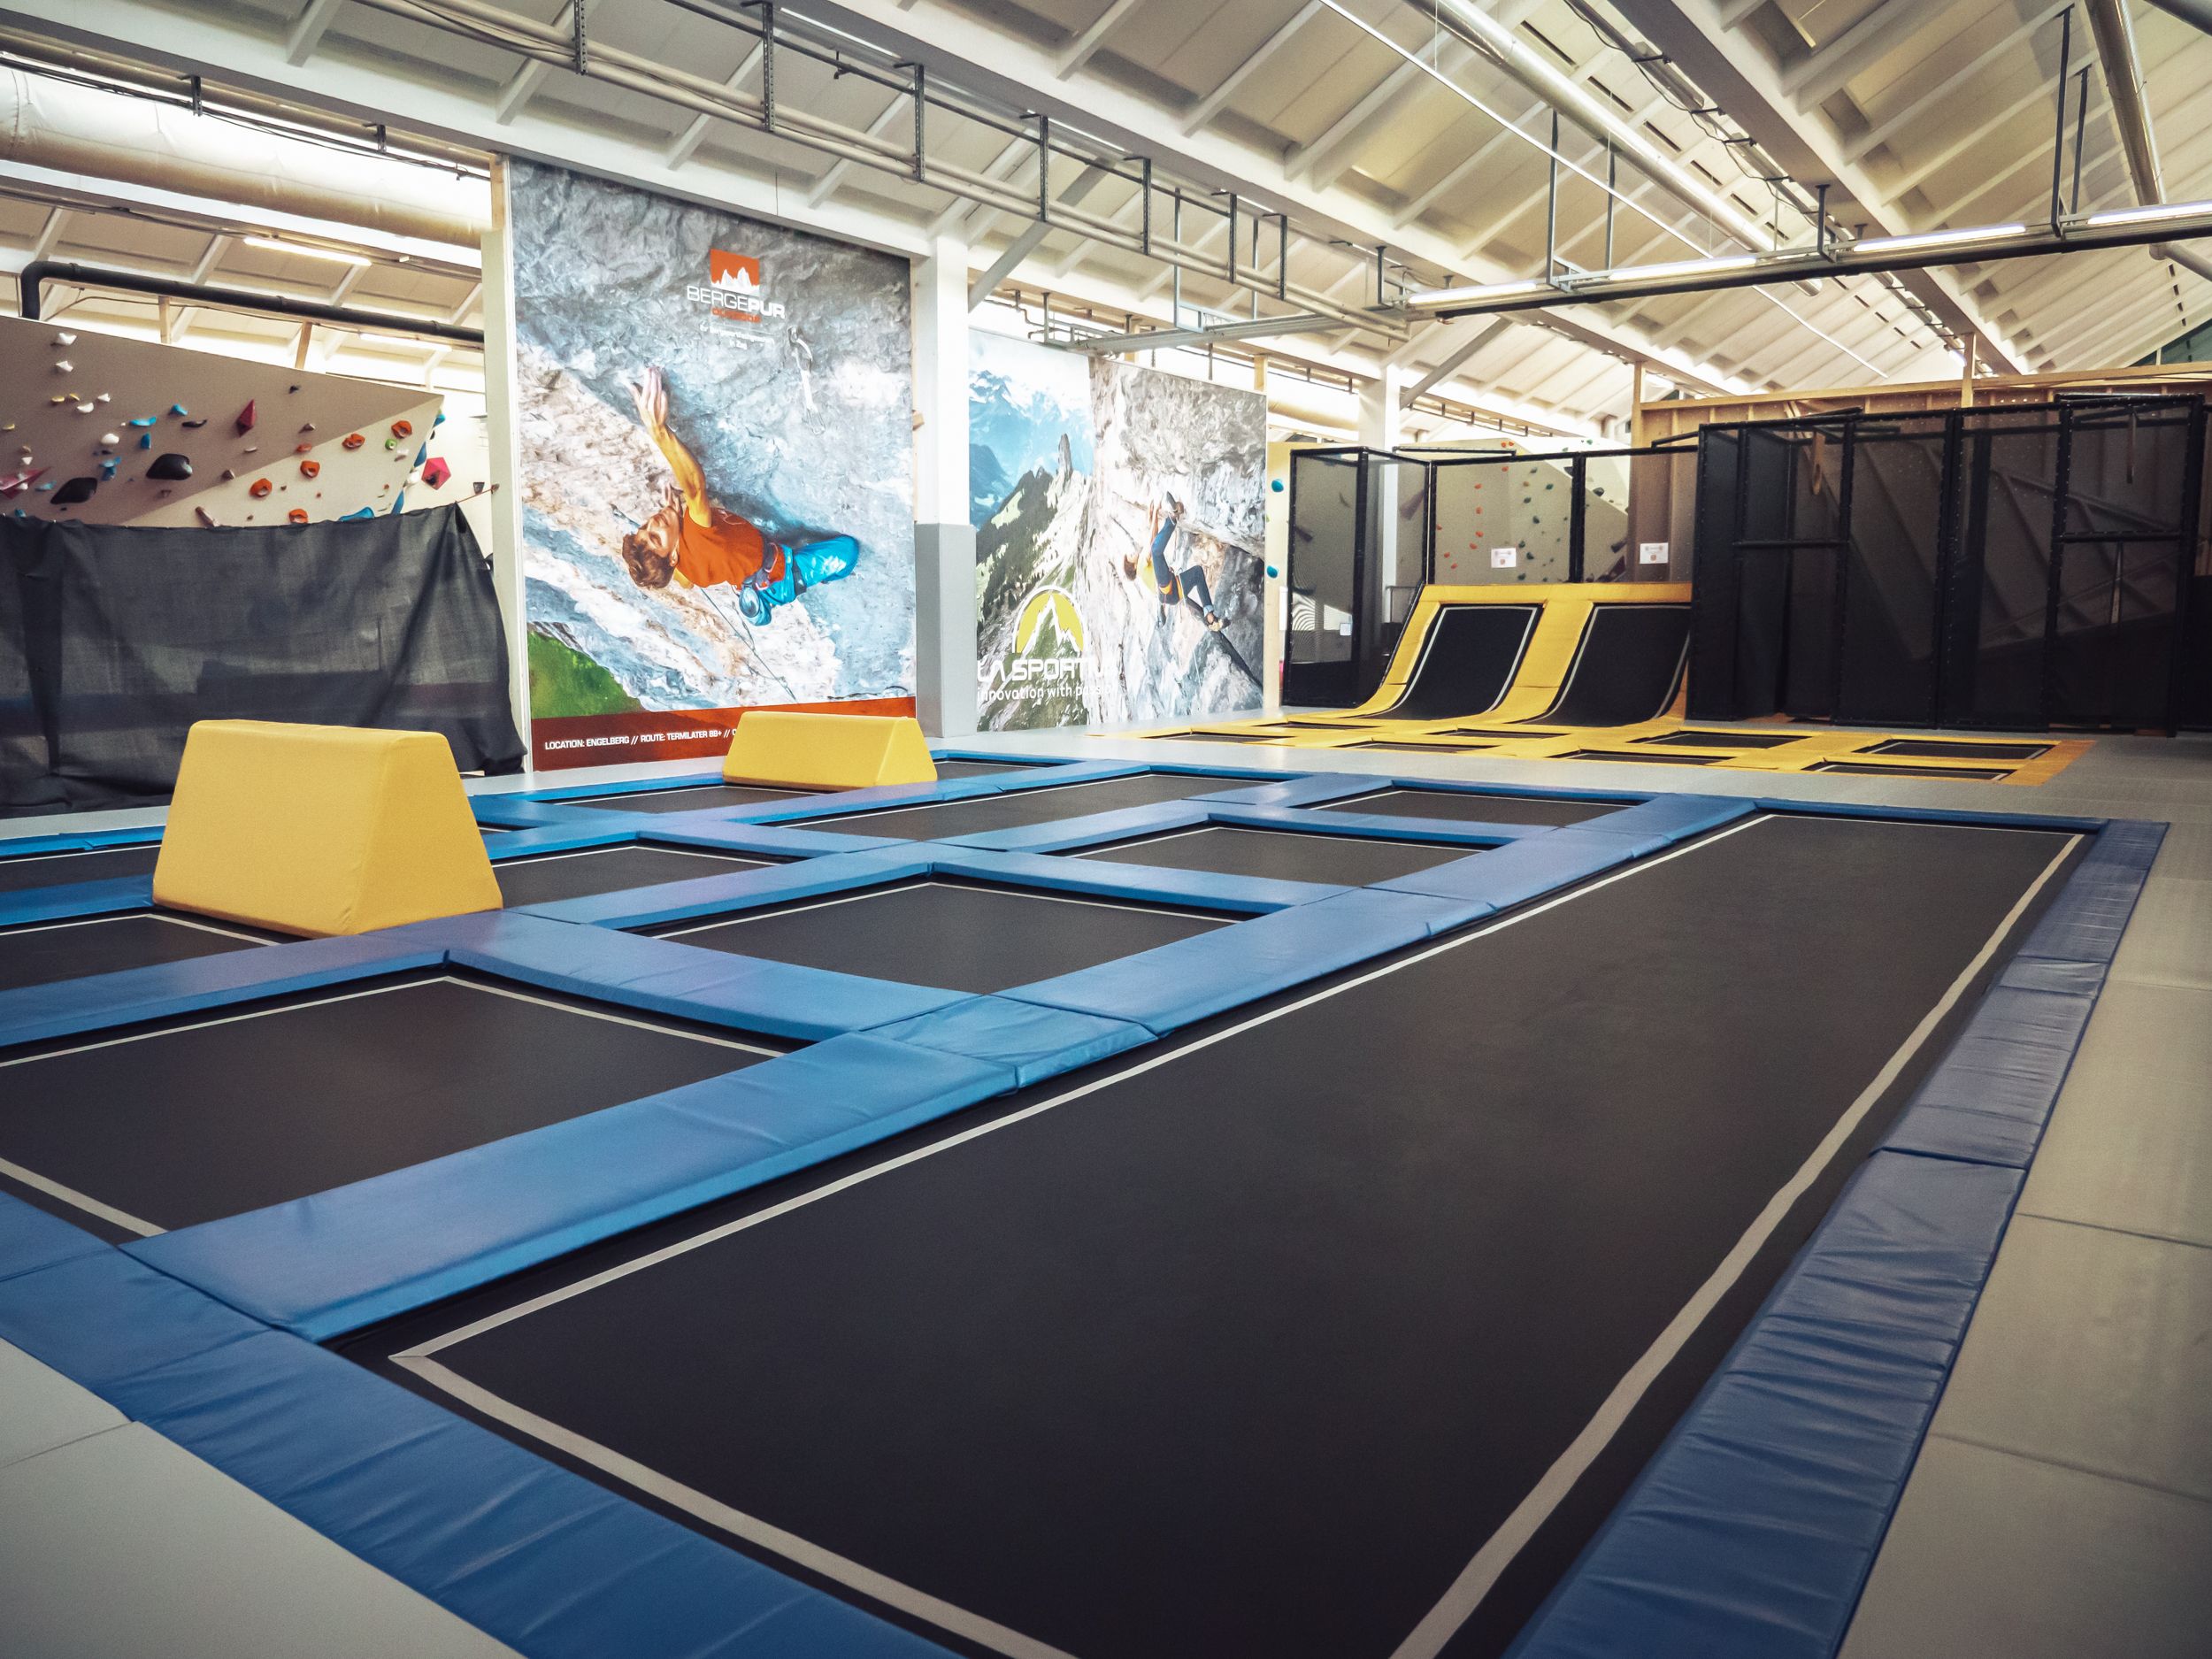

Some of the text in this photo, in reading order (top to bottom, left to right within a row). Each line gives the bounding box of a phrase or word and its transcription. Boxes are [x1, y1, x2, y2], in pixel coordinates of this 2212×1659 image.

[687, 285, 786, 319] BERGEPUR
[1011, 657, 1109, 681] SPORT
[1048, 683, 1072, 698] with
[544, 740, 585, 749] LOCATION:
[586, 736, 629, 747] ENGELBERG
[640, 733, 666, 742] ROUTE:
